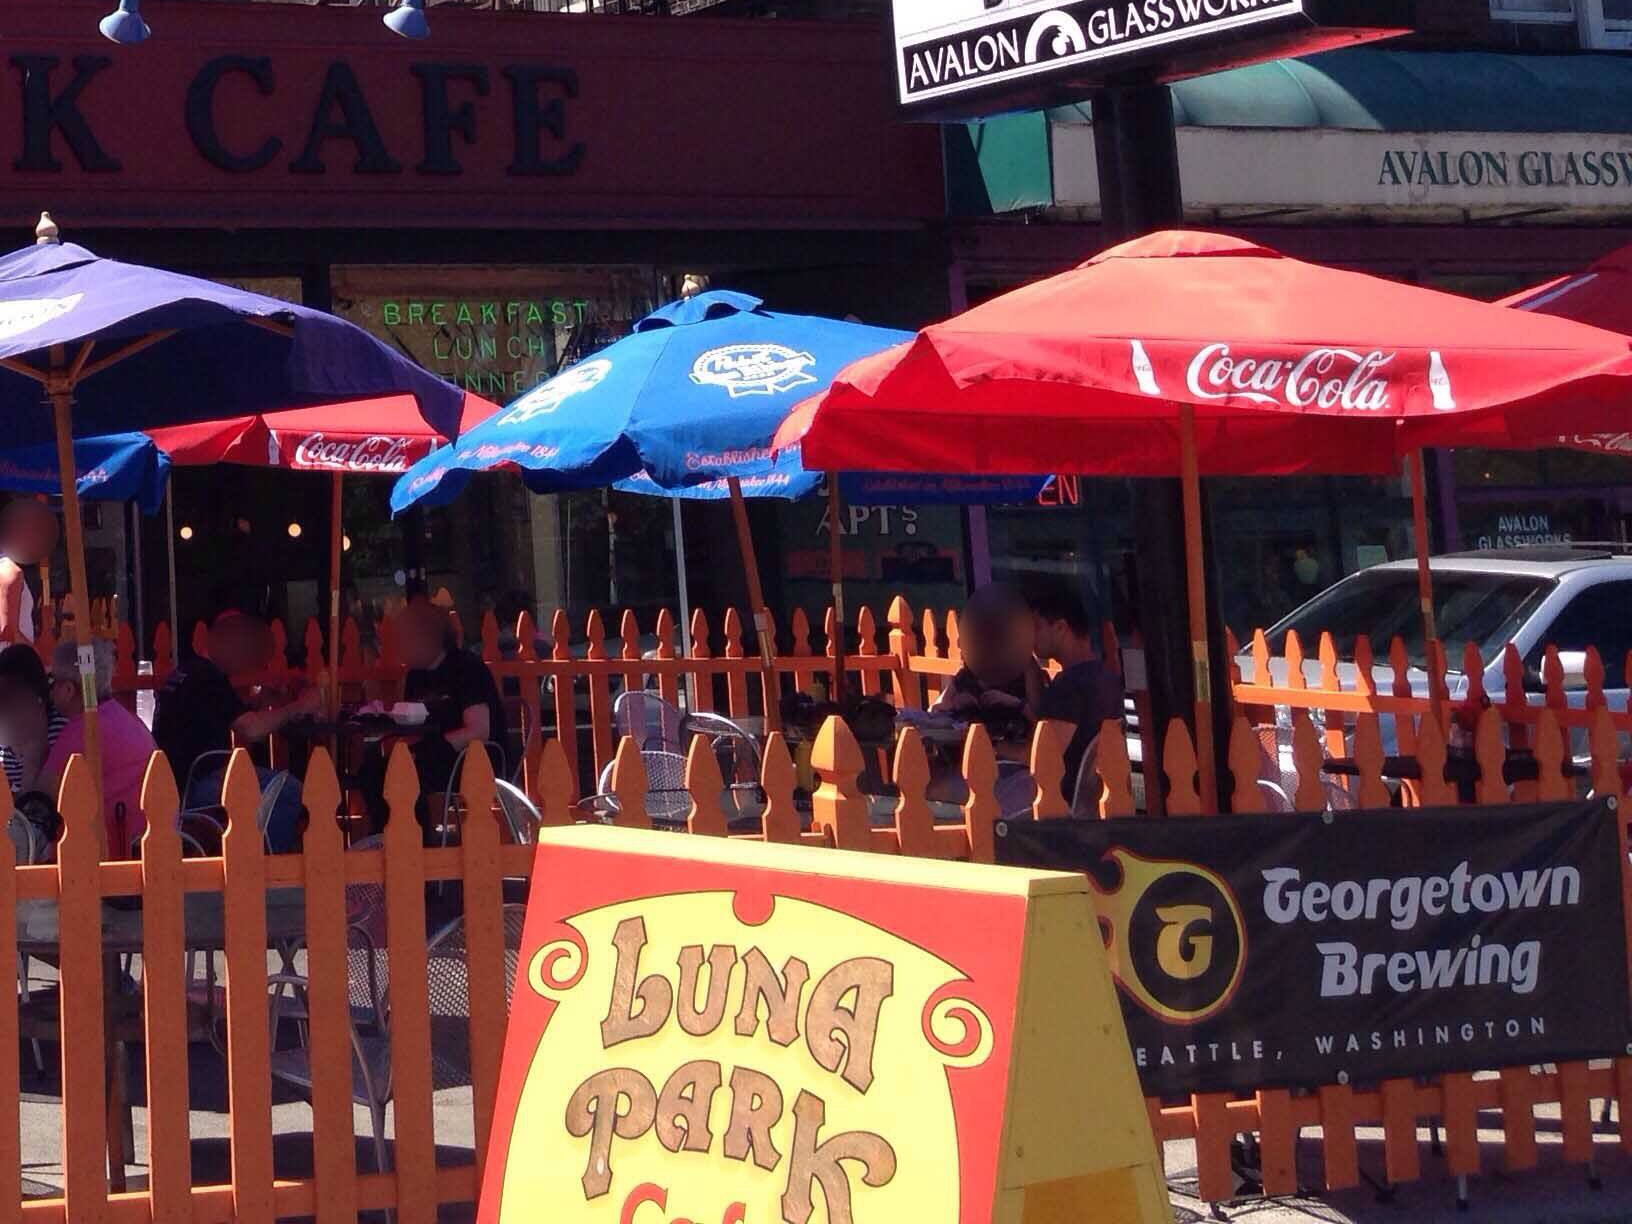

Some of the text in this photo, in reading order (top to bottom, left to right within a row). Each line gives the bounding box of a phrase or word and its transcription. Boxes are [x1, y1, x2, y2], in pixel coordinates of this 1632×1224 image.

[909, 29, 1020, 90] AVALON
[184, 54, 589, 178] CAFE
[1377, 150, 1509, 187] AVALON
[383, 302, 588, 327] BREAKFAST
[433, 336, 545, 360] LUNCH
[1498, 515, 1549, 531] AVALON
[1261, 861, 1580, 930] Georgetown
[1316, 934, 1542, 997] Brewing
[601, 915, 895, 1095] LUNA
[1136, 1017, 1547, 1067] EATTLE, WASHINGTON
[565, 1059, 898, 1224] PARK
